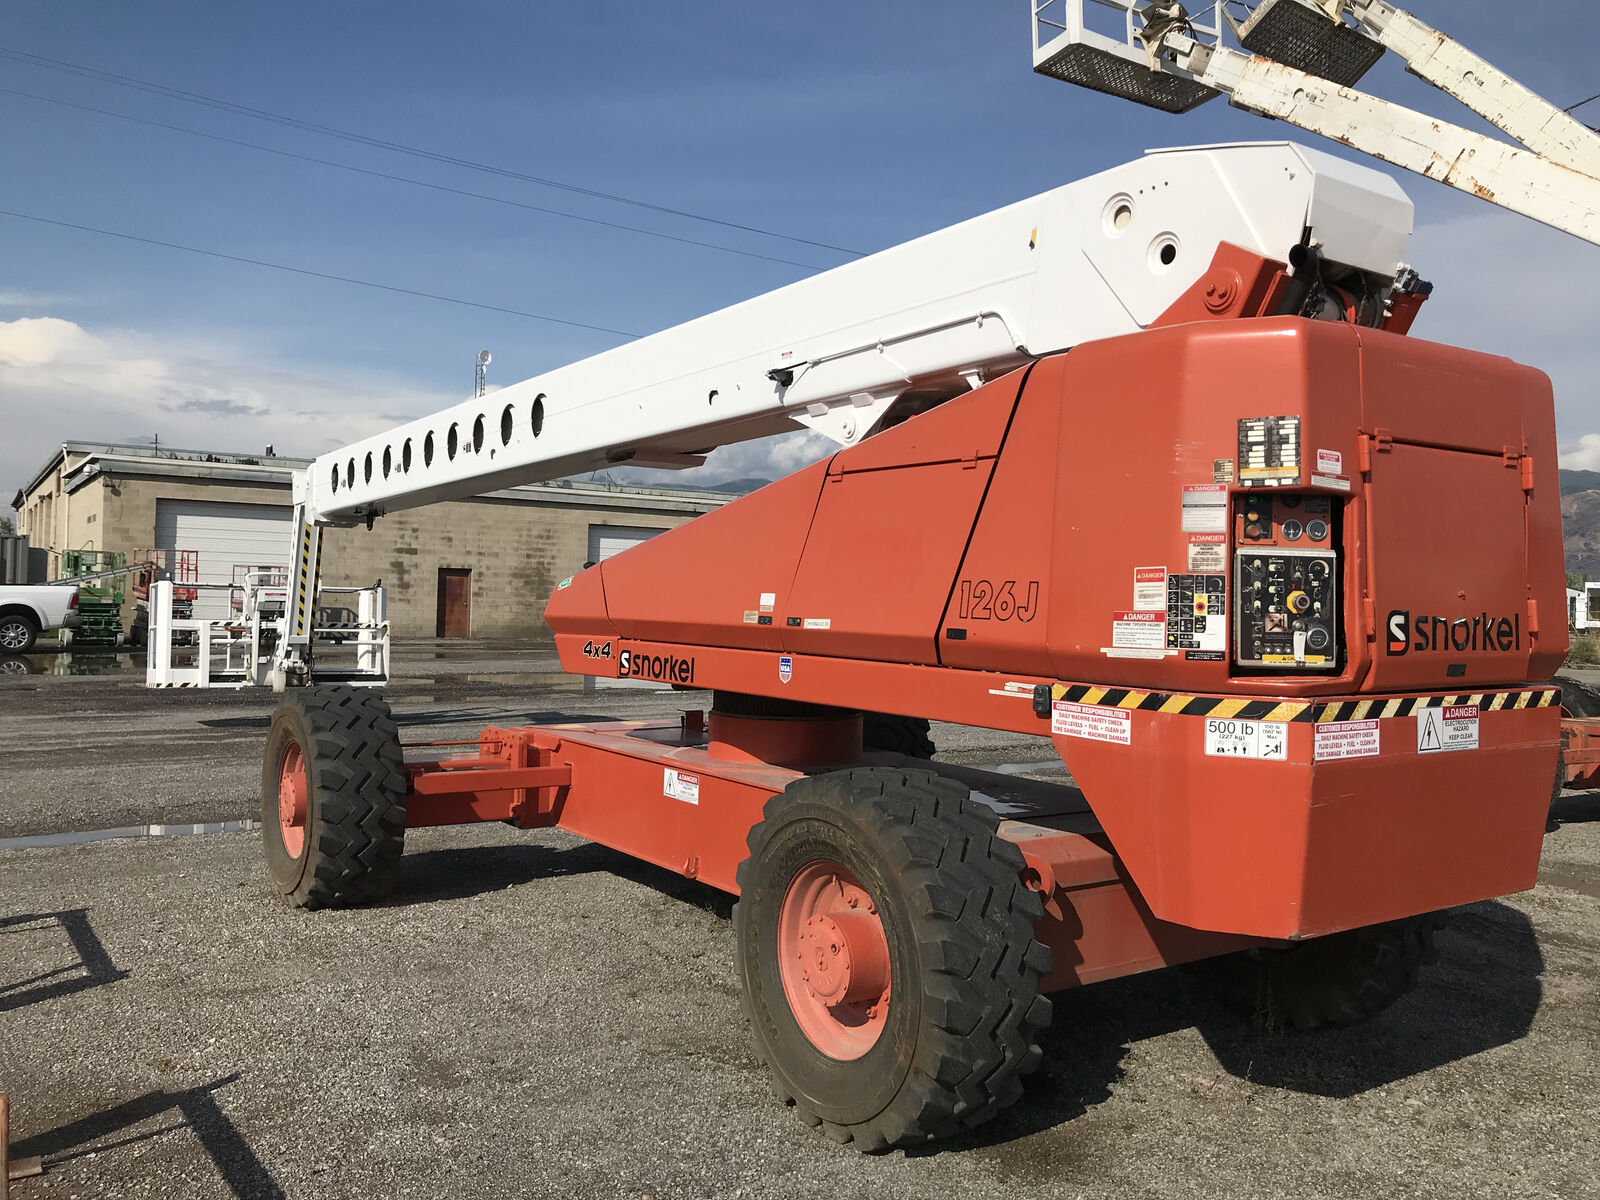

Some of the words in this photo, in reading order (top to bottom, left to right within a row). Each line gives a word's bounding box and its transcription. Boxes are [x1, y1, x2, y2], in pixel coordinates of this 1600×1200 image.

[960, 580, 1039, 622] 126J
[1414, 612, 1520, 652] snorkel
[583, 640, 612, 659] 4x4
[632, 654, 695, 683] snorkel
[1056, 703, 1082, 713] CUSTOMER
[1451, 707, 1477, 717] DANGER
[1091, 716, 1107, 724] SAFETY
[1209, 721, 1235, 734] 500
[1241, 723, 1253, 735] lb
